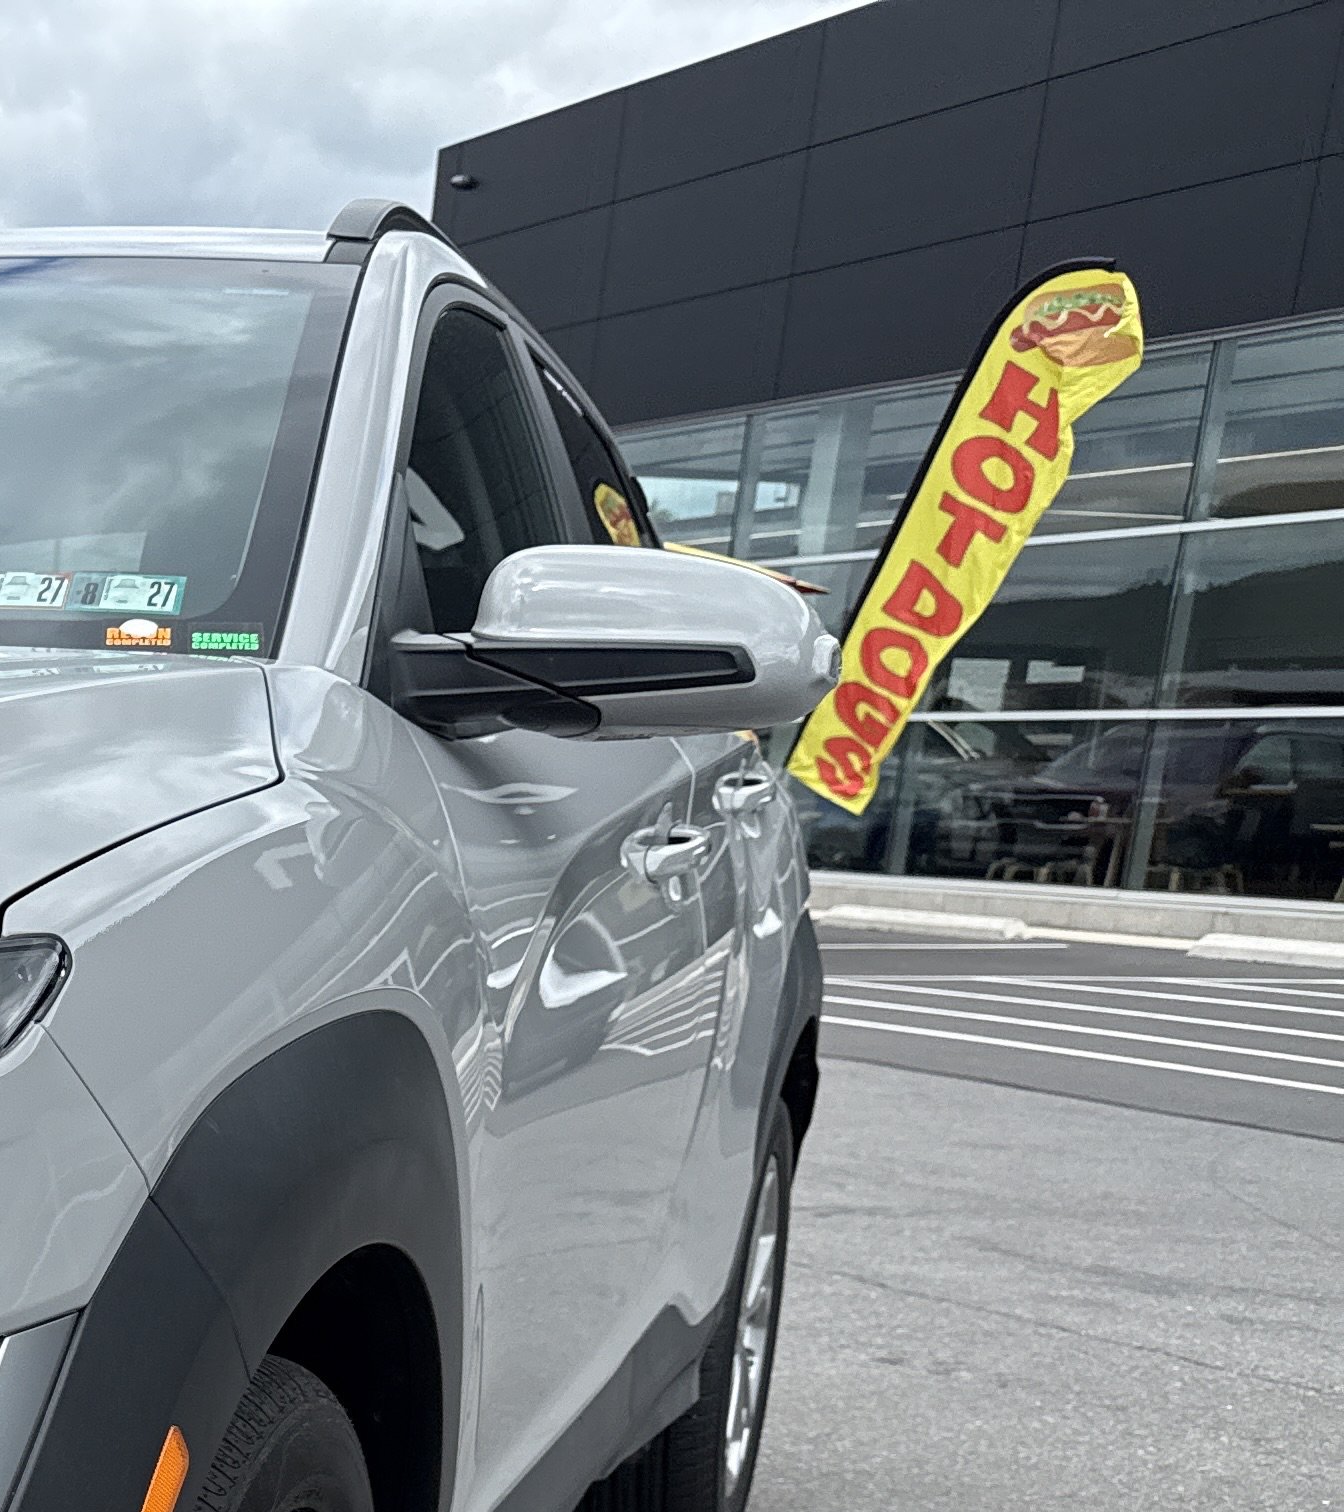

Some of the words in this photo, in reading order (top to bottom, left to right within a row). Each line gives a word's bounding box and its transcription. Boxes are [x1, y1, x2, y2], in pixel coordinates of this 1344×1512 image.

[936, 360, 1060, 568] HOT
[36, 577, 65, 604] 27
[81, 582, 98, 605] 8
[147, 581, 176, 608] 27
[192, 632, 258, 643] SERVICE
[192, 642, 259, 650] COMPLETED
[815, 559, 963, 798] DOGS
